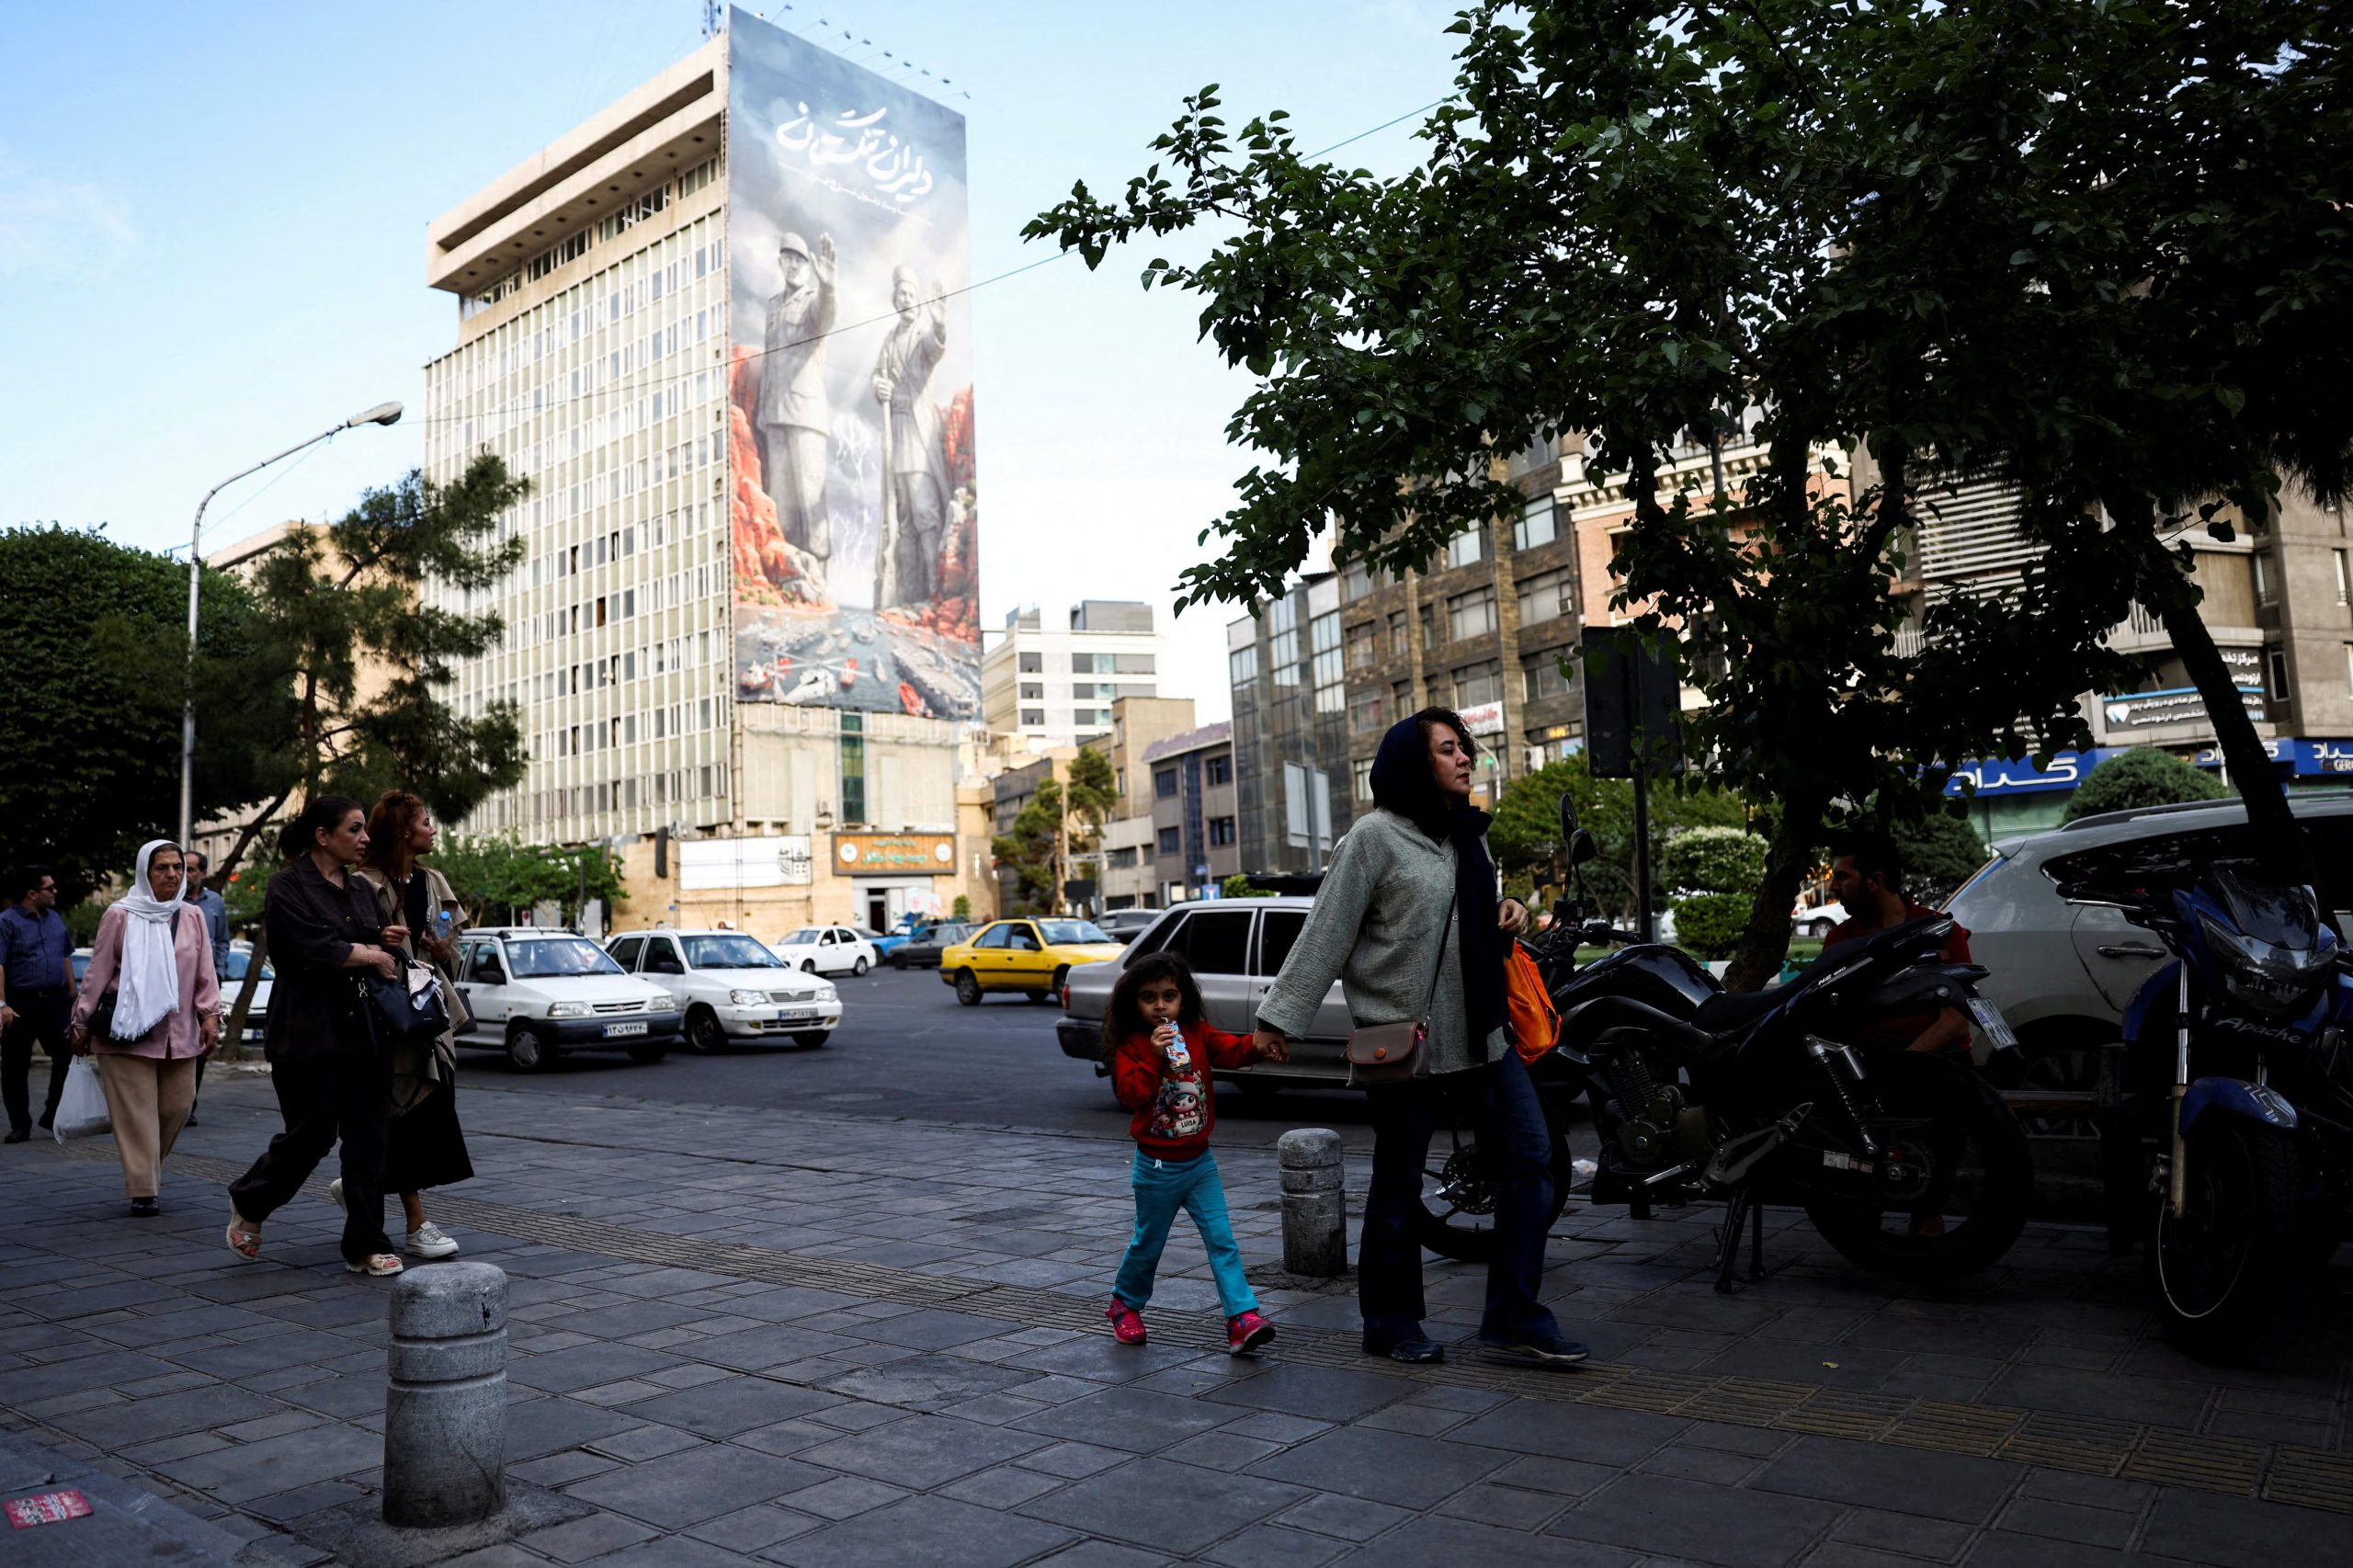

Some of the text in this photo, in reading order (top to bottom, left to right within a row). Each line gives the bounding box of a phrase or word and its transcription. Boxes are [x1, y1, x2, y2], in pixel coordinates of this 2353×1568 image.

[776, 101, 888, 165] تنگستان
[867, 135, 933, 203] دلیران
[2236, 653, 2258, 665] مرکز
[2188, 694, 2203, 705] دکتر
[2131, 710, 2205, 724] متخصص ارتودنسی
[2313, 742, 2353, 759] راد
[2333, 759, 2353, 772] GER
[2214, 1017, 2302, 1044] Apache
[1181, 1119, 1196, 1128] LUISA
